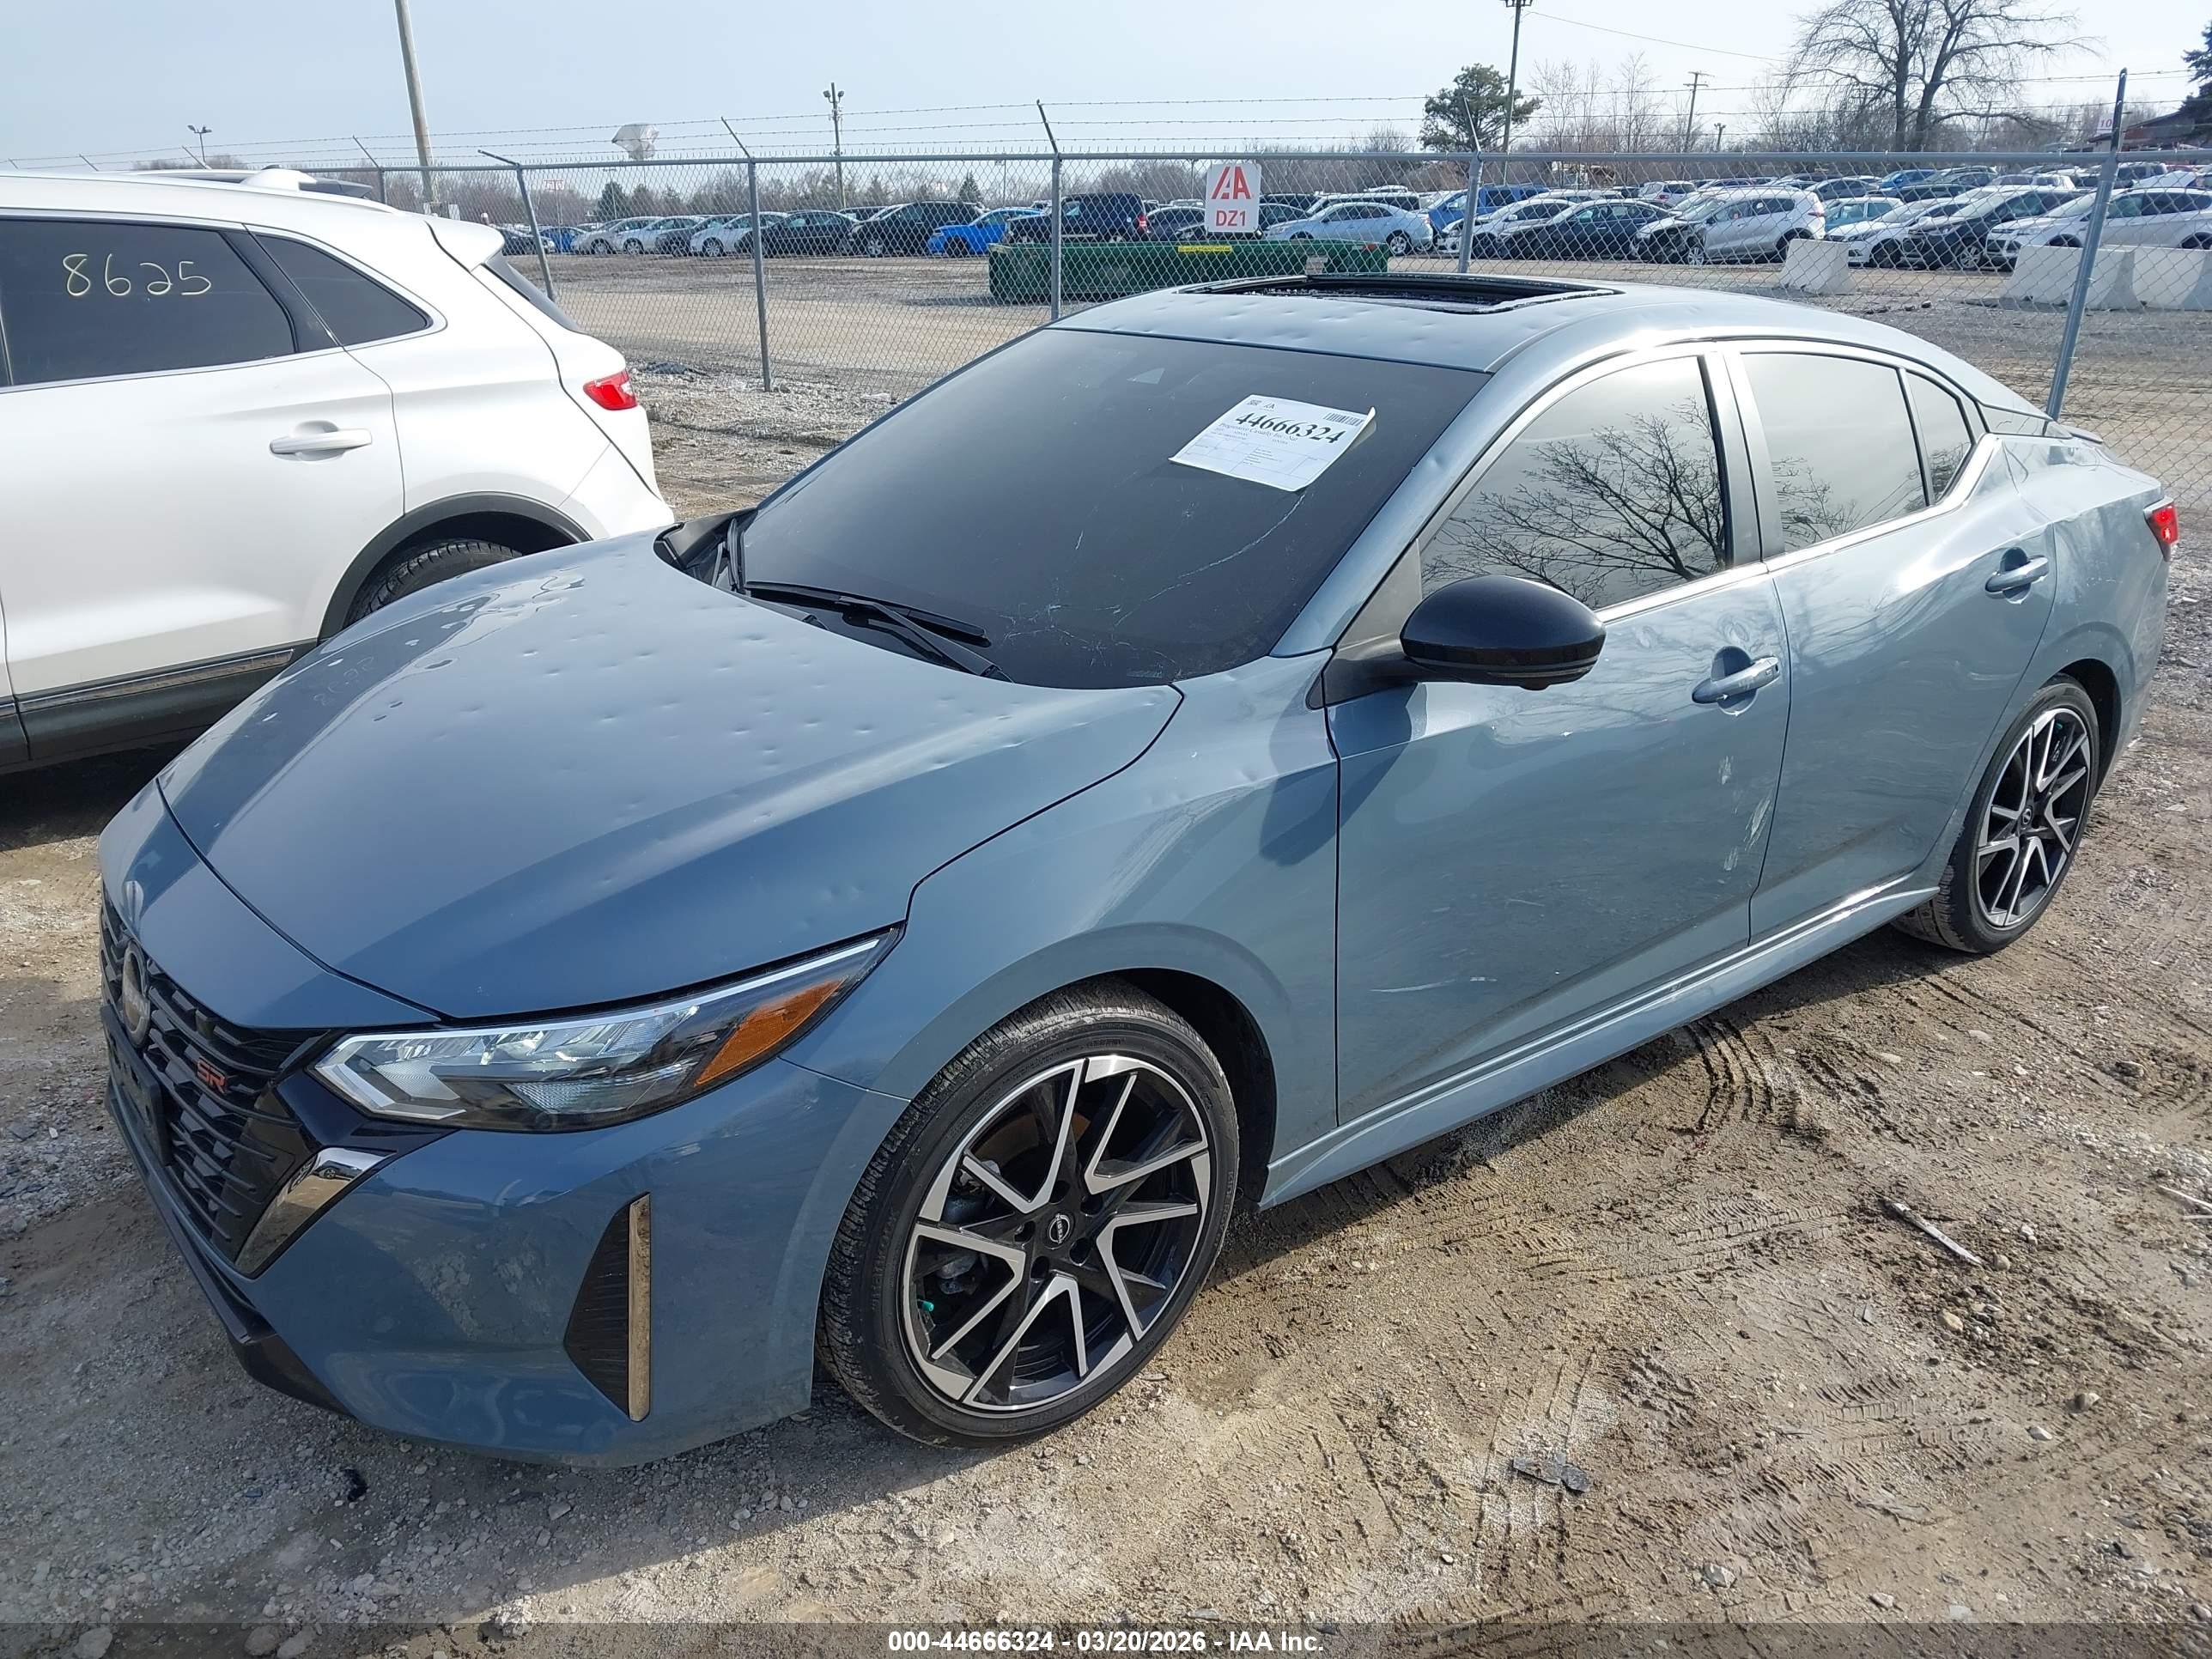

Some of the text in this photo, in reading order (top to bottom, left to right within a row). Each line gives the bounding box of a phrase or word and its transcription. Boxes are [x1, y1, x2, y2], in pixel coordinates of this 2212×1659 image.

[1216, 210, 1246, 227] DZ1
[63, 253, 212, 296] 8625
[1236, 413, 1346, 444] 44666324
[197, 1060, 226, 1094] SR
